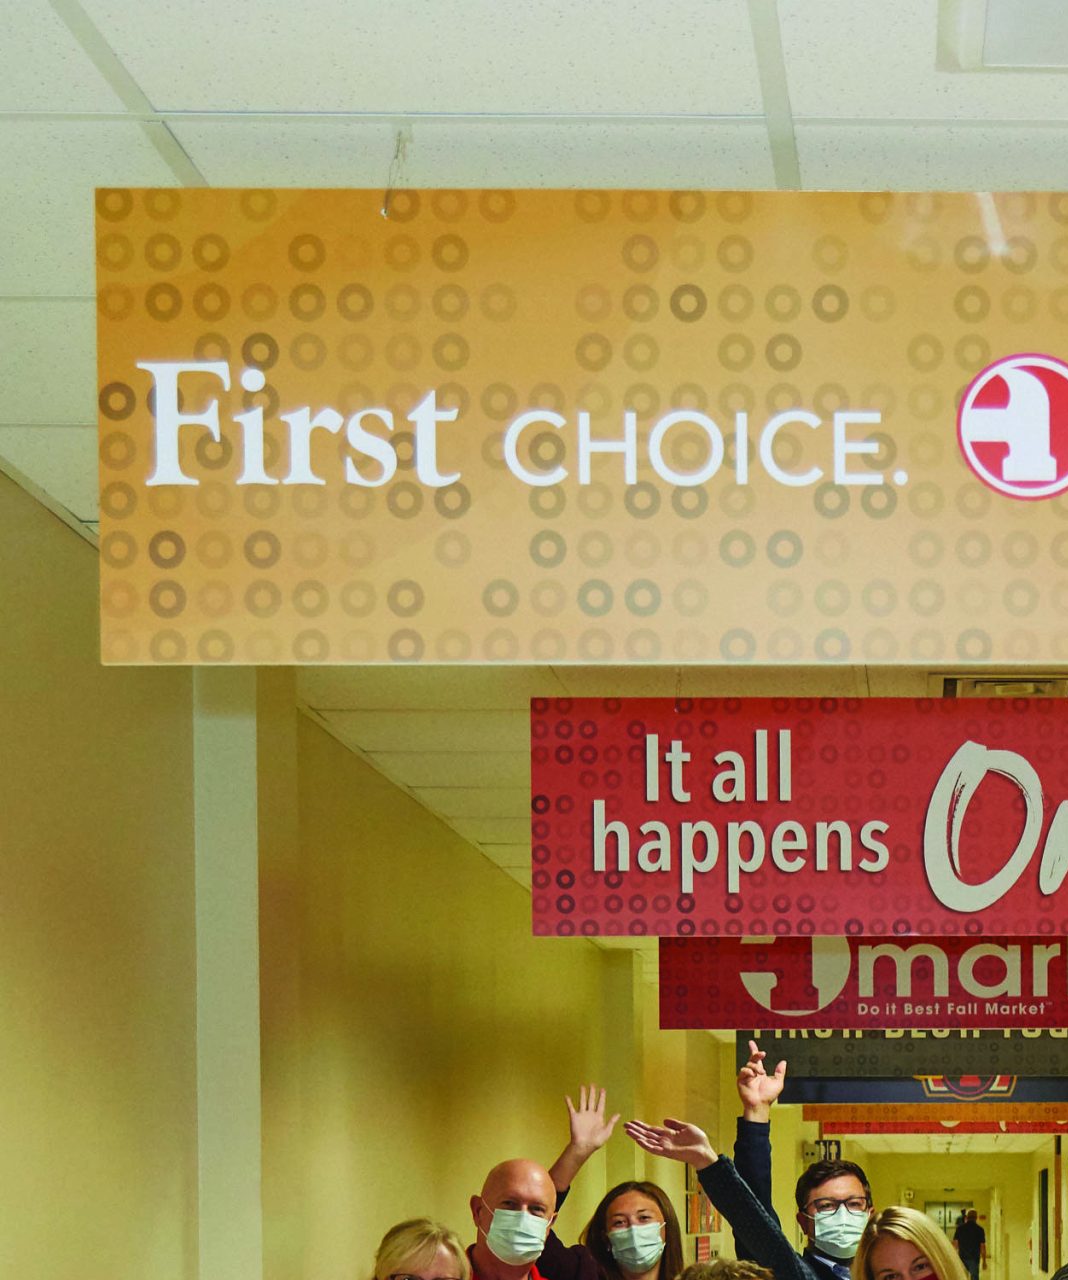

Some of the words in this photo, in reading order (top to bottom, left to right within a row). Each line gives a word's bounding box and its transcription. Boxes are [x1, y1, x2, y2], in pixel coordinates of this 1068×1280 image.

[137, 360, 461, 487] First
[503, 409, 908, 486] CHOICE.
[646, 733, 691, 803] It
[712, 729, 793, 802] all
[593, 800, 890, 894] happens
[857, 1002, 880, 1015] Do
[885, 1002, 897, 1015] it
[903, 1002, 940, 1015] Best
[947, 1002, 978, 1015] Fall
[985, 1002, 1045, 1015] Market
